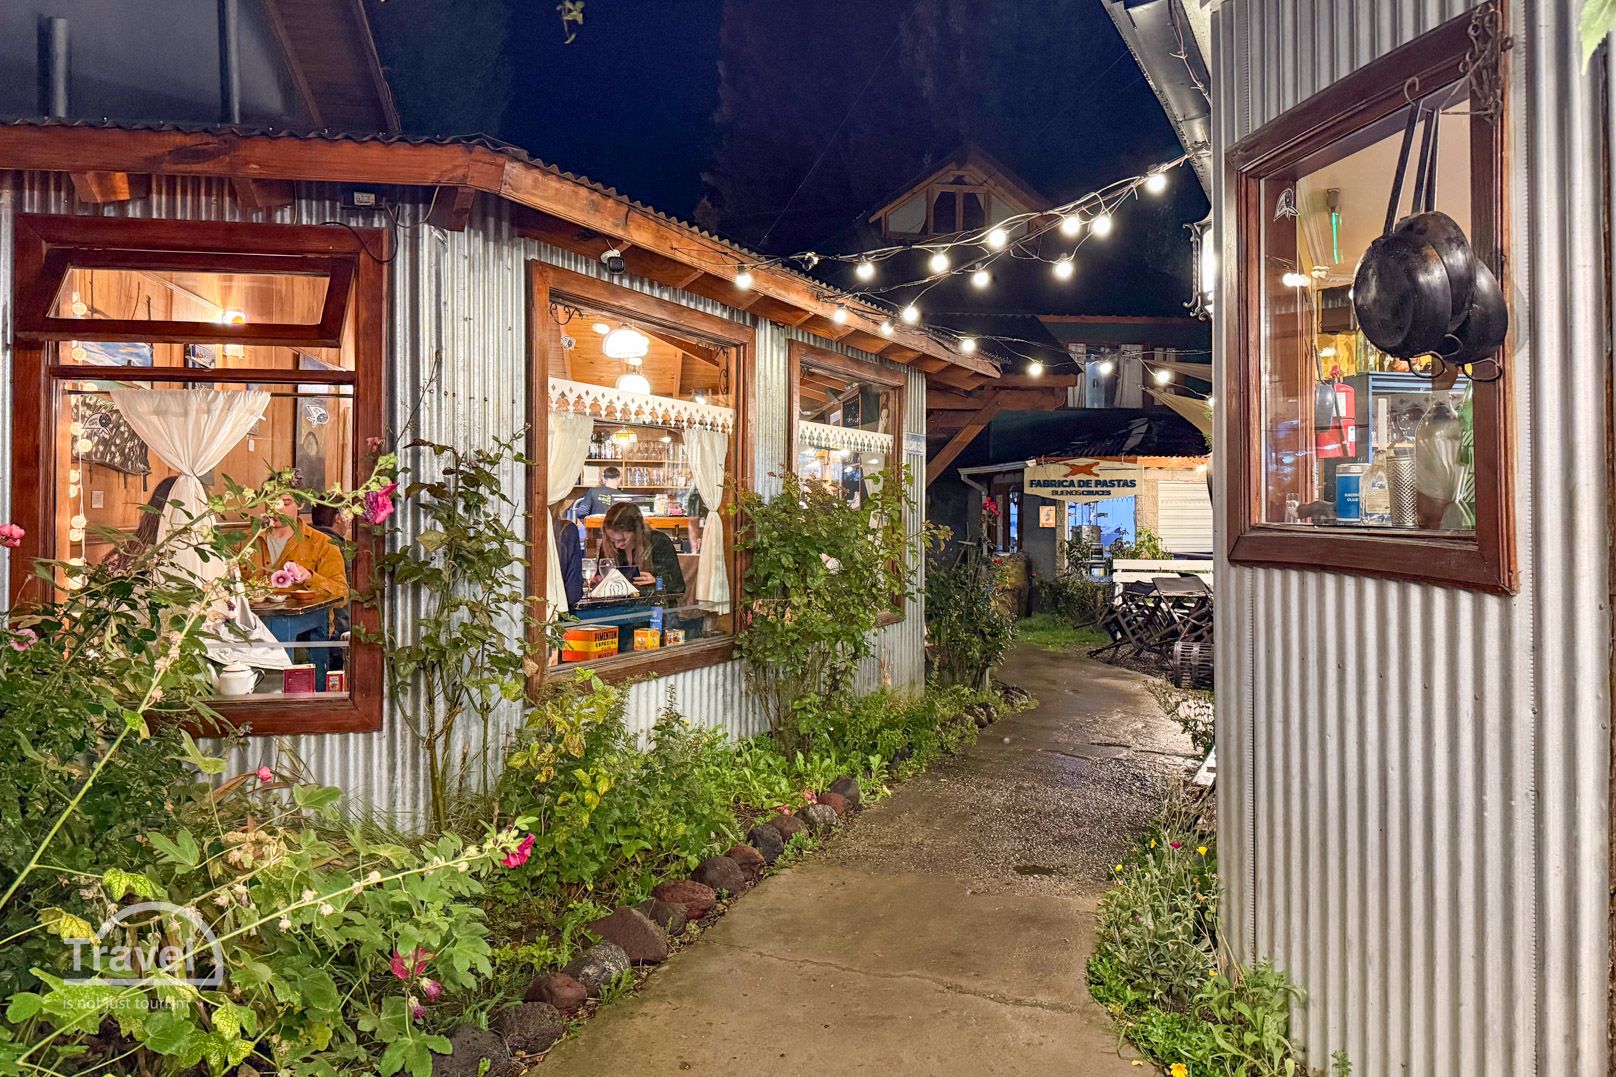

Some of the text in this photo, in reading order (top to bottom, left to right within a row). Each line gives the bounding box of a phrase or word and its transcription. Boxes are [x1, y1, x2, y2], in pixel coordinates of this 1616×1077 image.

[1029, 479, 1136, 488] FABRICA DE PASTAS
